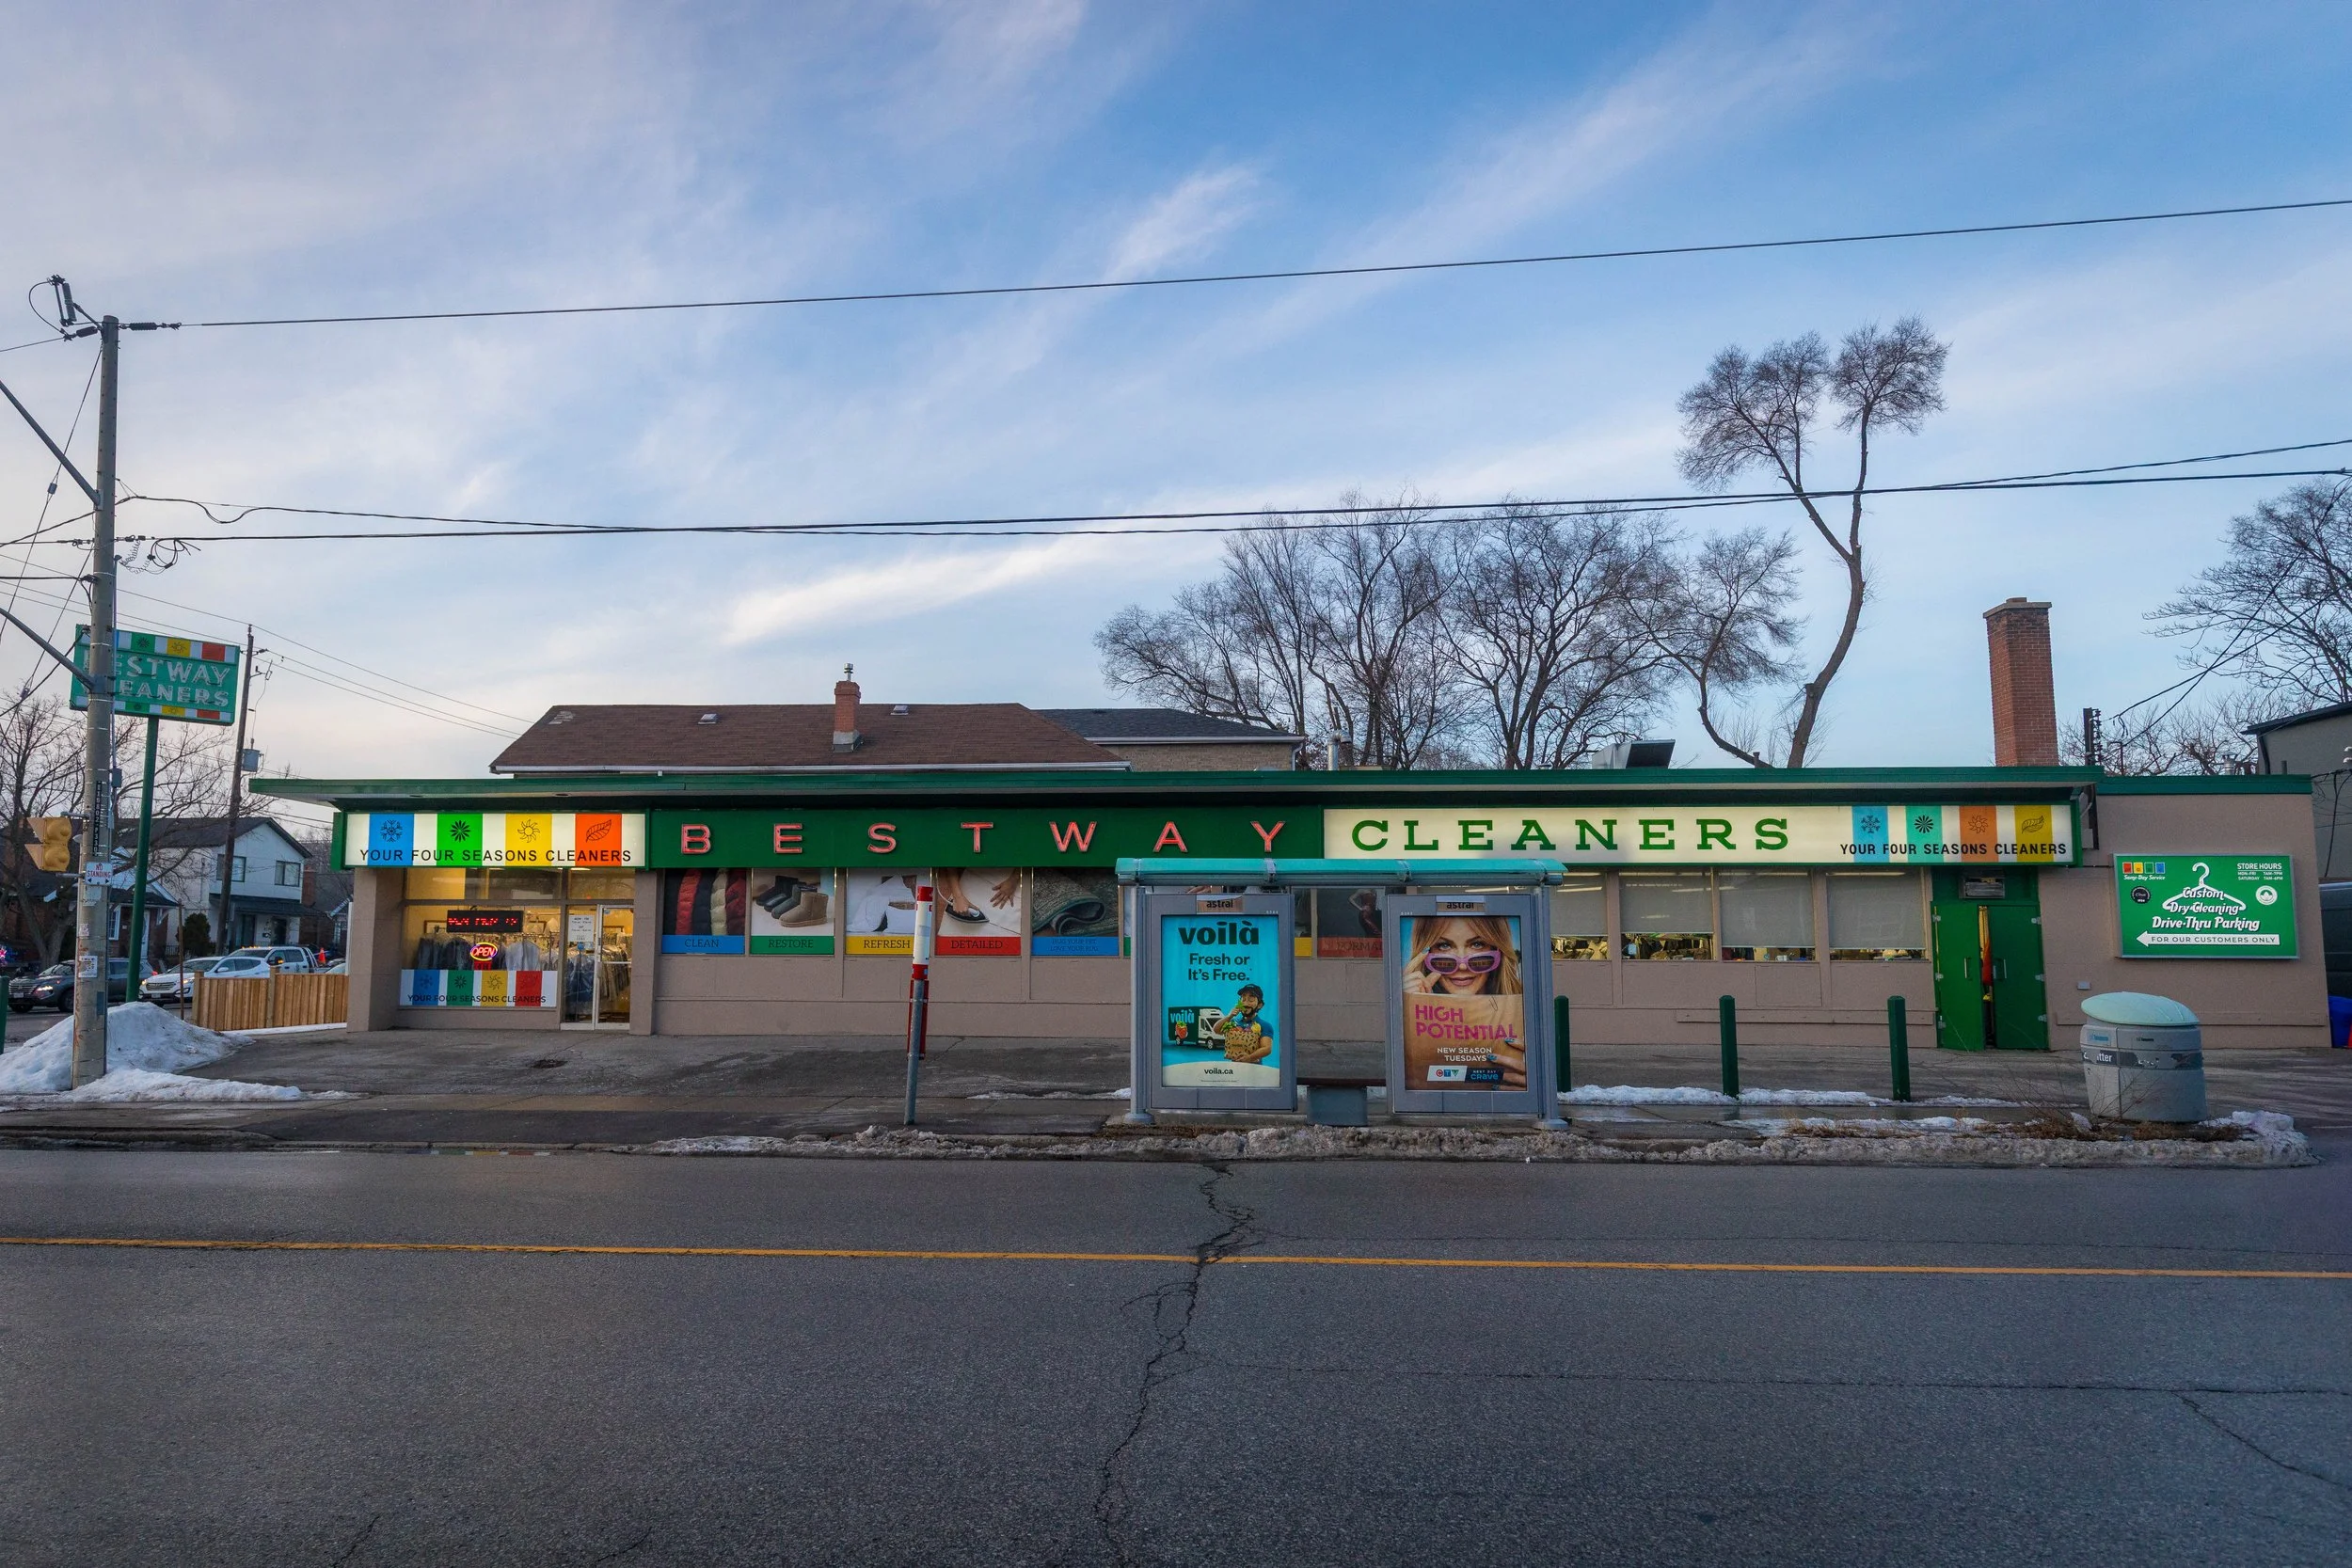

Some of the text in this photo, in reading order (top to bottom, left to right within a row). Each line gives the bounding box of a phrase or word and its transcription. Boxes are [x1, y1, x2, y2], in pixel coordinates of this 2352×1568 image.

[119, 678, 230, 706] EANERS
[680, 821, 1286, 854] BESTWAY
[1352, 817, 1789, 851] CLEANERS
[359, 849, 631, 862] YOUR FOUR SEASONS CLEANERS
[1840, 844, 2067, 855] YOUR FOUR SEASONS CLEANERS
[2183, 887, 2225, 900] Custom
[1206, 899, 1233, 909] astral
[2169, 901, 2240, 915] Dry Cleaning
[2152, 916, 2261, 931] Drive-Thru Parking
[1178, 920, 1260, 945] voilà
[684, 939, 719, 948] CLEAN
[768, 939, 814, 949] RESTORE
[863, 940, 911, 949] REFRESH
[950, 940, 1003, 949] DETAILED
[1336, 941, 1382, 951] FORMA
[471, 946, 495, 957] OPEN
[1189, 953, 1250, 965] Fresh or
[434, 994, 457, 1003] FOUR
[459, 994, 500, 1003] SEASONS
[501, 995, 547, 1004] CLEANERS
[1169, 1008, 1195, 1024] voilà
[1414, 1004, 1464, 1022] HIGH
[1415, 1022, 1518, 1040] POTENTIAL
[1436, 1069, 1460, 1077] CTV
